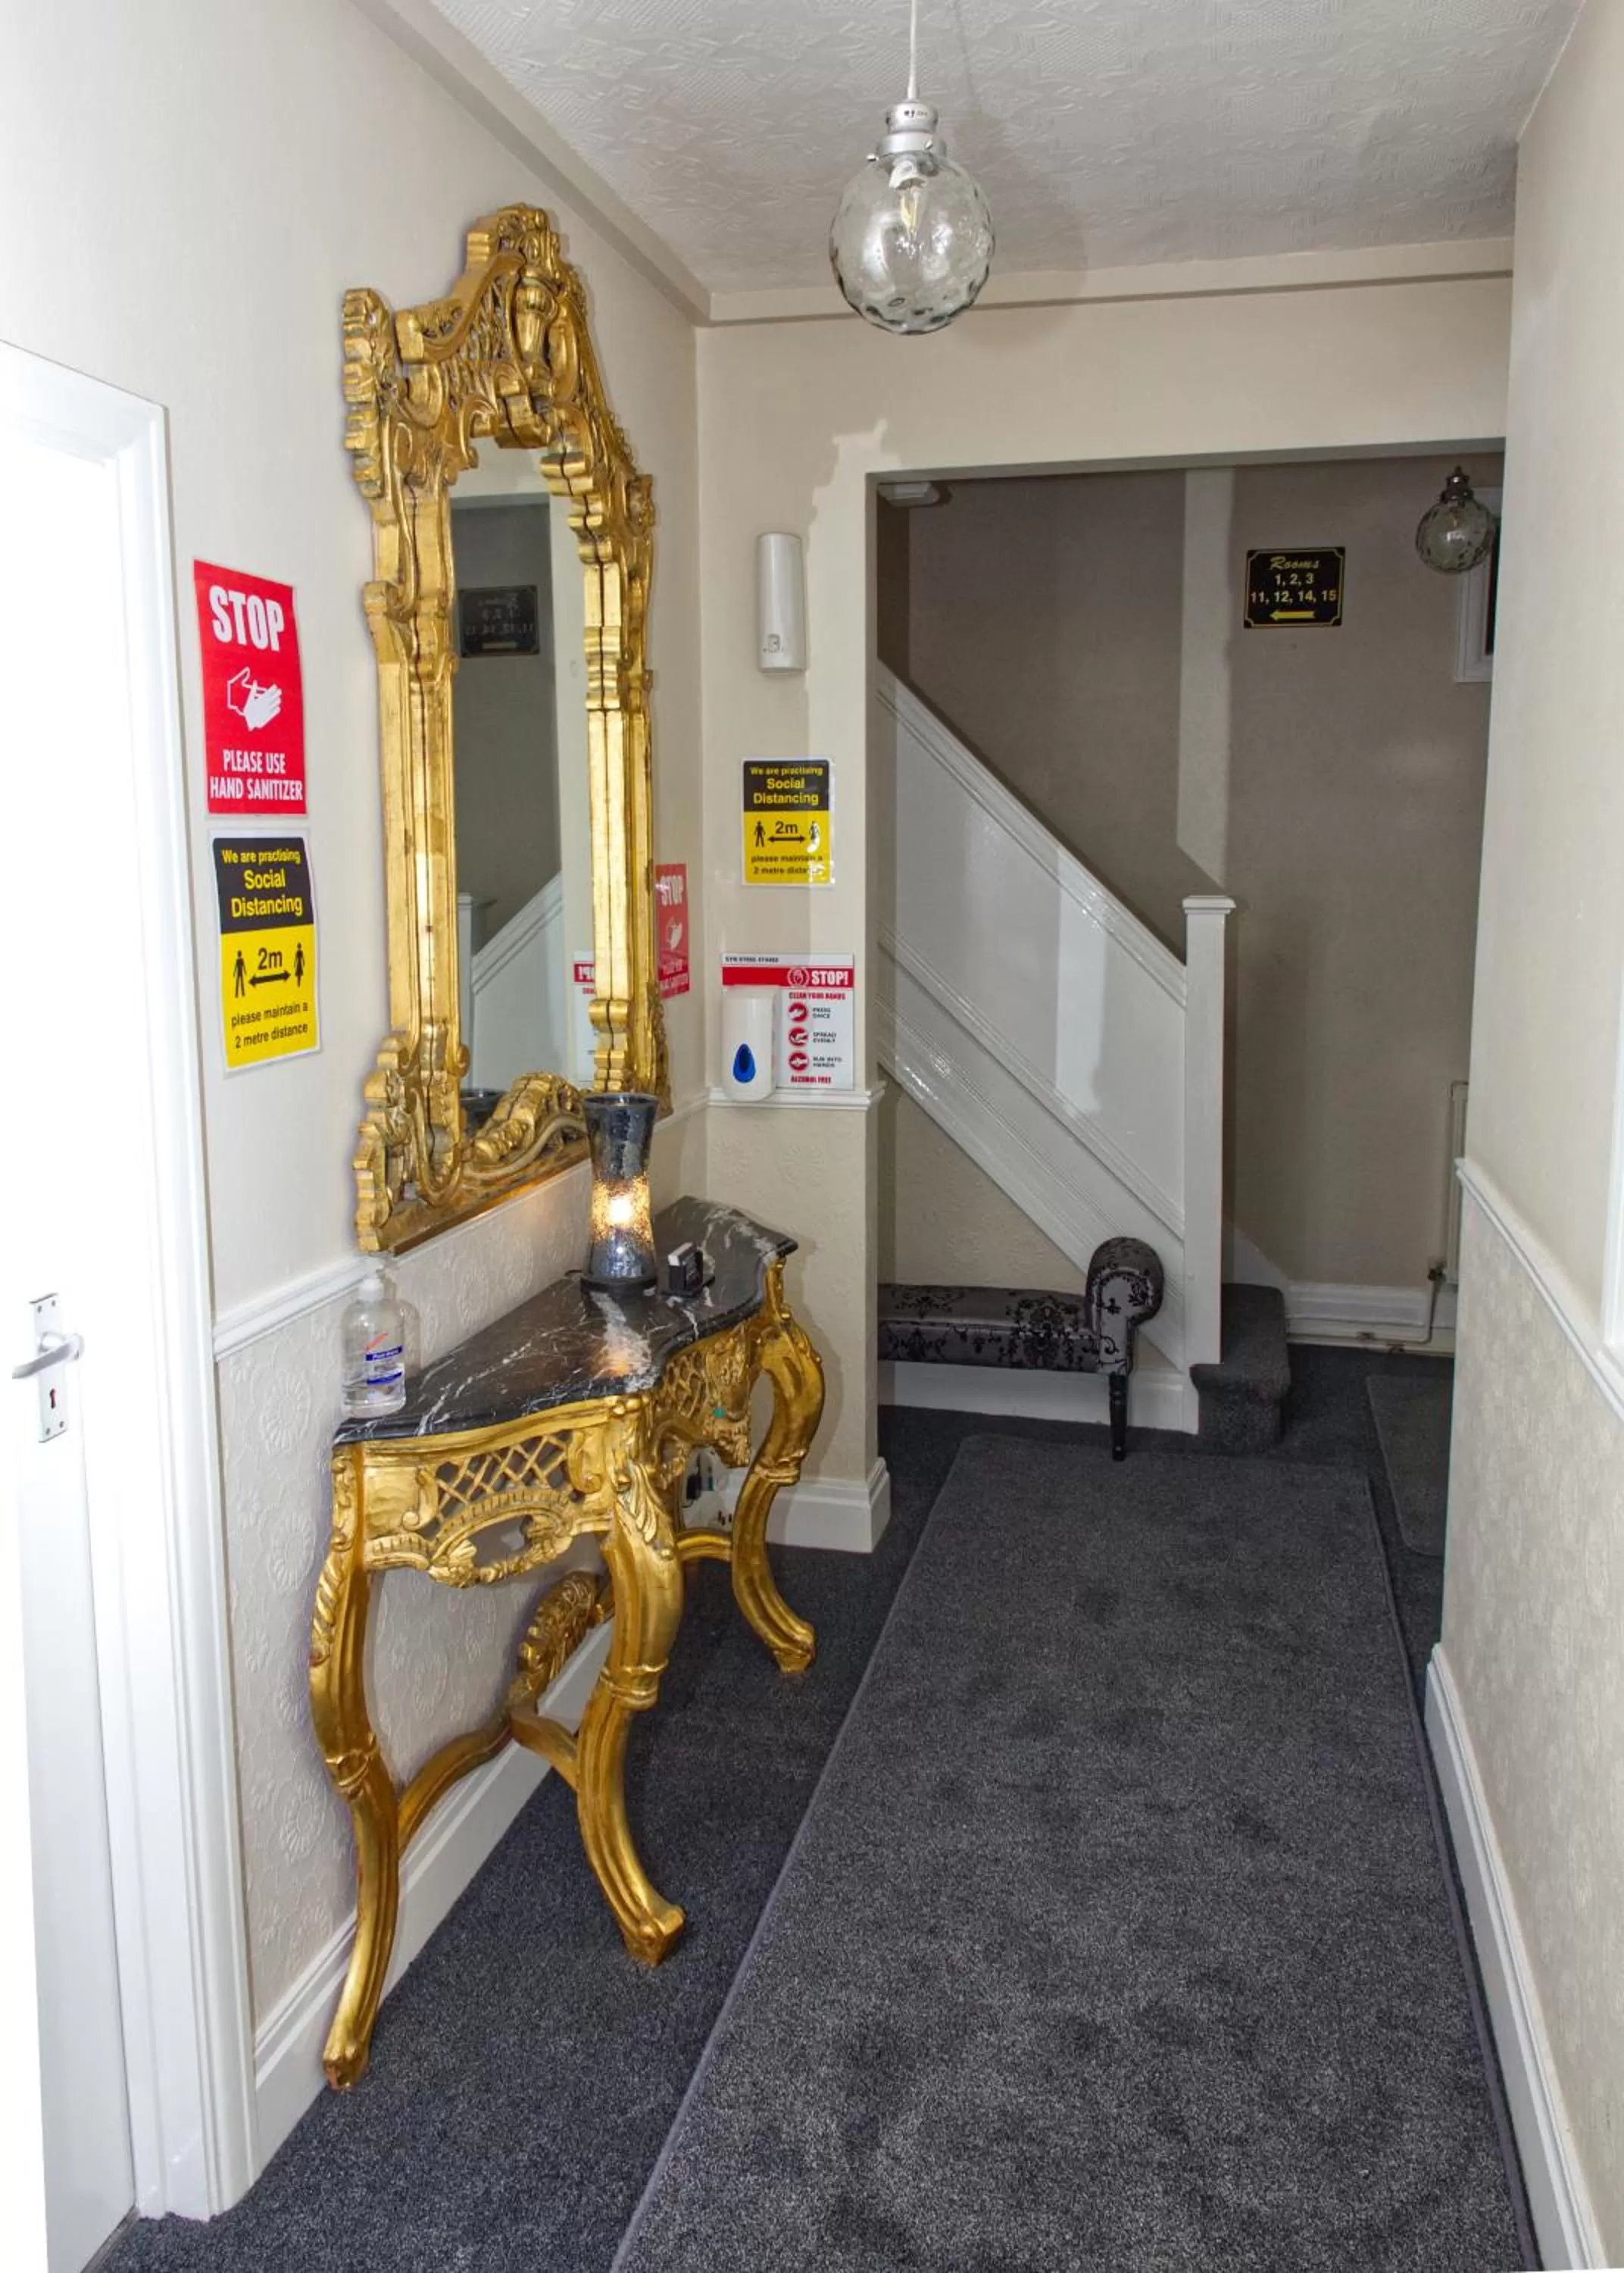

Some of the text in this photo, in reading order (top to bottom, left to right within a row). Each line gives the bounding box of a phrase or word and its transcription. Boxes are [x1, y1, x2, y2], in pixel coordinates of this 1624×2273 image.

[1270, 556, 1320, 570] Rooms
[1275, 573, 1314, 587] 1, 2, 3
[1251, 589, 1336, 605] 11, 12, 14, 15
[209, 585, 285, 652] STOP
[223, 749, 286, 774] PLEASE USE
[751, 767, 763, 775] We
[781, 767, 823, 776] practising
[210, 776, 303, 801] HAND SANITIZER
[767, 778, 805, 789] Social
[753, 793, 819, 805] Distancing
[775, 821, 798, 834] 2m
[221, 848, 301, 865] We are practising
[244, 869, 286, 890] Social
[660, 874, 683, 907] STOP
[231, 896, 302, 918] Distancing
[258, 947, 283, 971] 2m
[811, 971, 848, 985] STOP!
[231, 1002, 308, 1029] please maintain a
[236, 1021, 308, 1049] 2 metre distance
